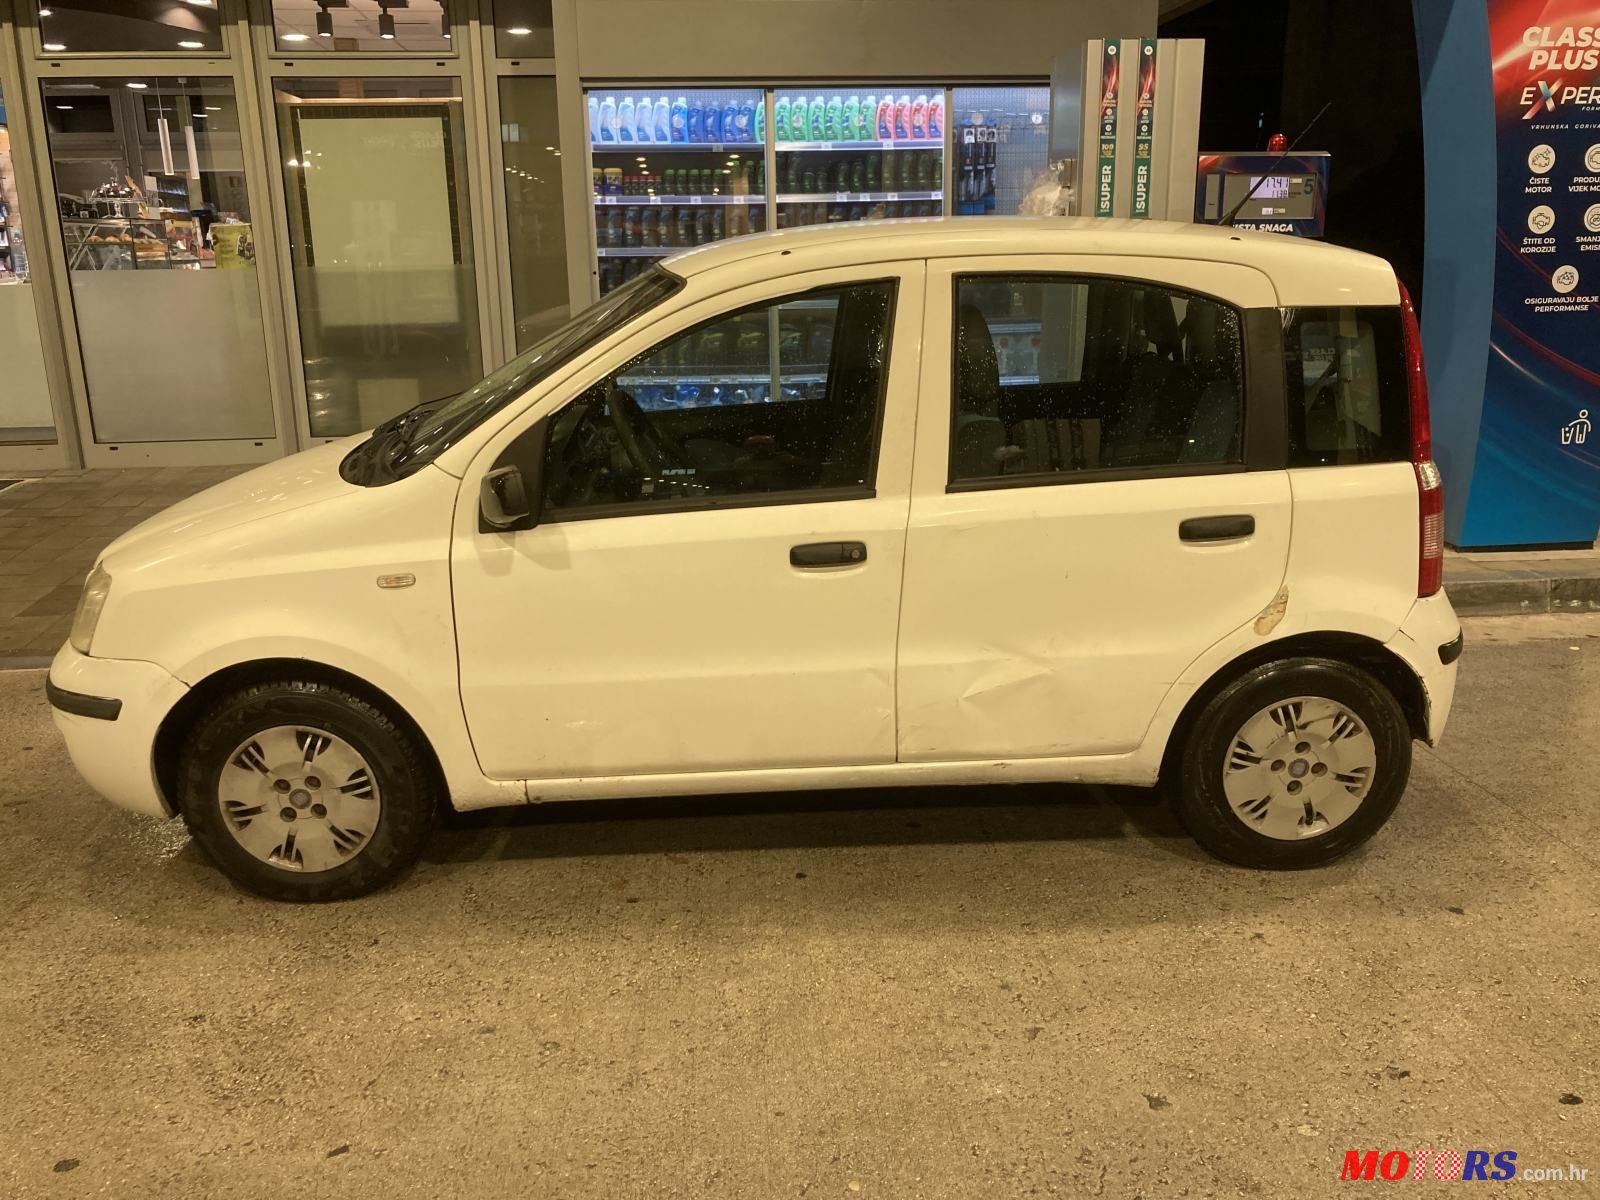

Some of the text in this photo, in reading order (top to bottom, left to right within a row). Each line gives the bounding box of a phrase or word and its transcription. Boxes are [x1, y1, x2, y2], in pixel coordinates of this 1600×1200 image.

[1528, 49, 1600, 70] PLUS
[1304, 179, 1314, 194] 5
[1529, 176, 1550, 185] ČISTE
[1100, 165, 1112, 209] SUPER
[1136, 165, 1148, 209] SUPER
[1233, 223, 1294, 233] ISTA SNAGA
[1523, 237, 1543, 245] ŠTITE
[1535, 304, 1589, 312] PERFORMANSE
